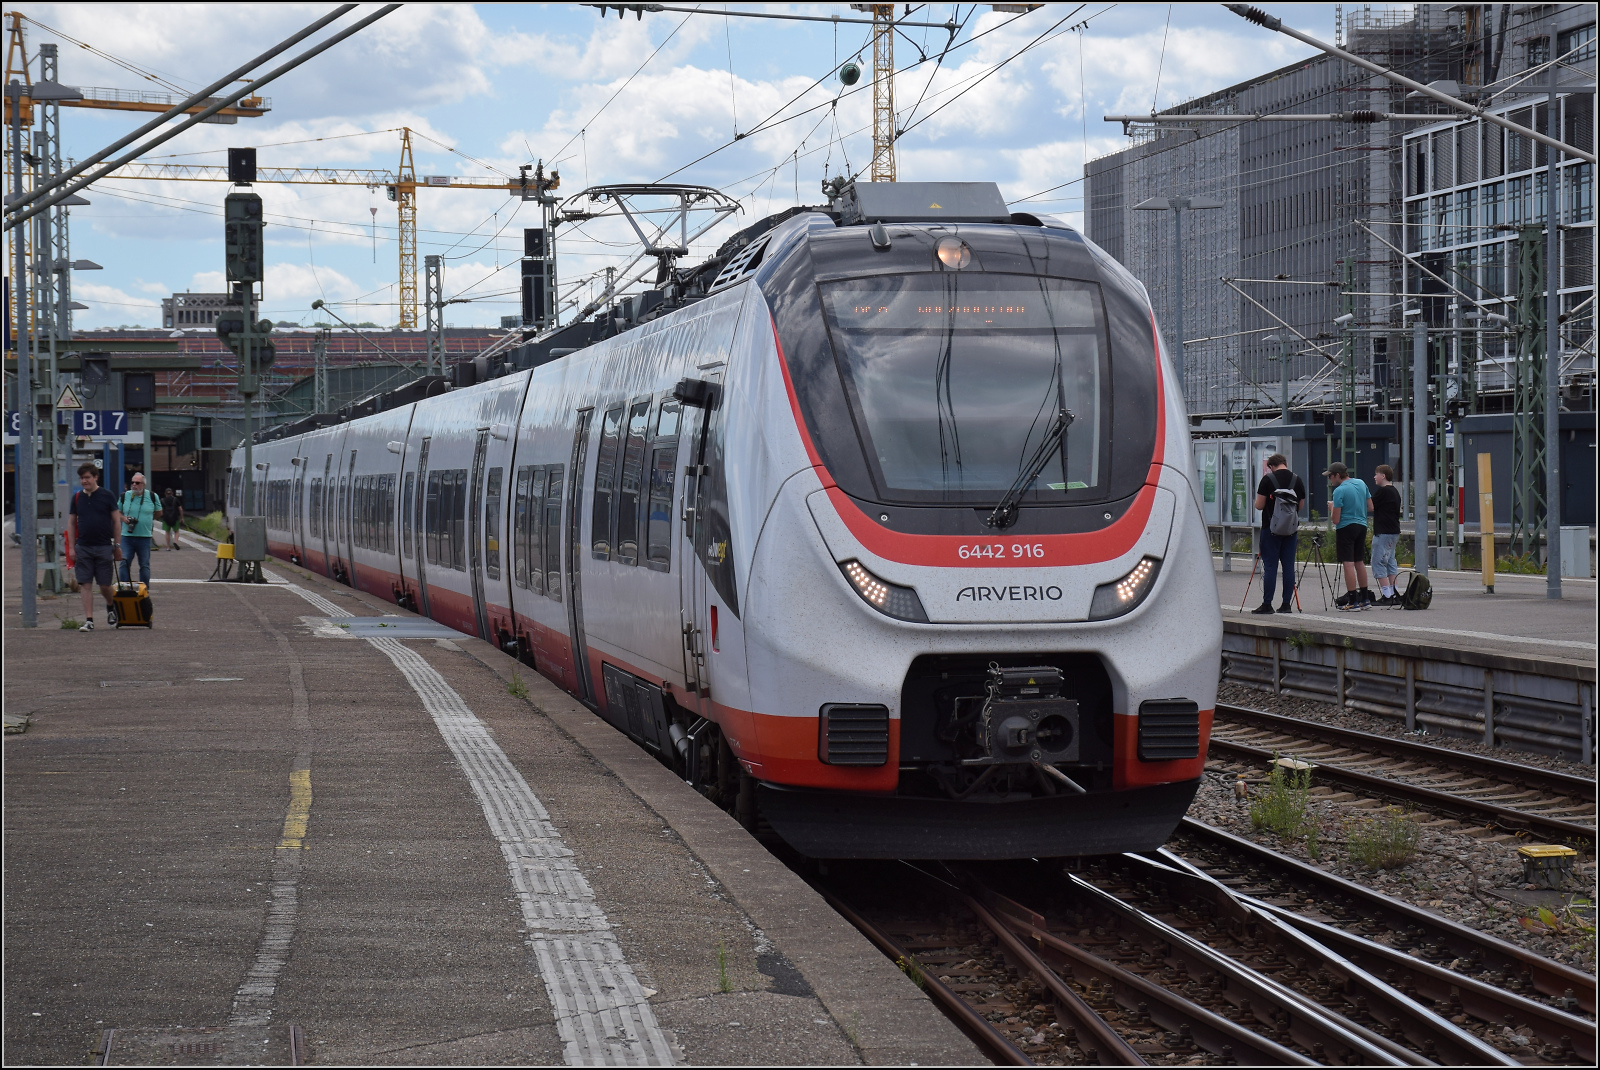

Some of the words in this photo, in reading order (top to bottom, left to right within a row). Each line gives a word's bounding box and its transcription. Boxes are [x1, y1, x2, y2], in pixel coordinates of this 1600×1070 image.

[83, 412, 97, 430] B
[112, 412, 124, 430] 7
[1427, 434, 1434, 444] E
[958, 544, 1005, 559] 6442
[1011, 543, 1045, 558] 916
[956, 585, 1063, 601] ARVERIO
